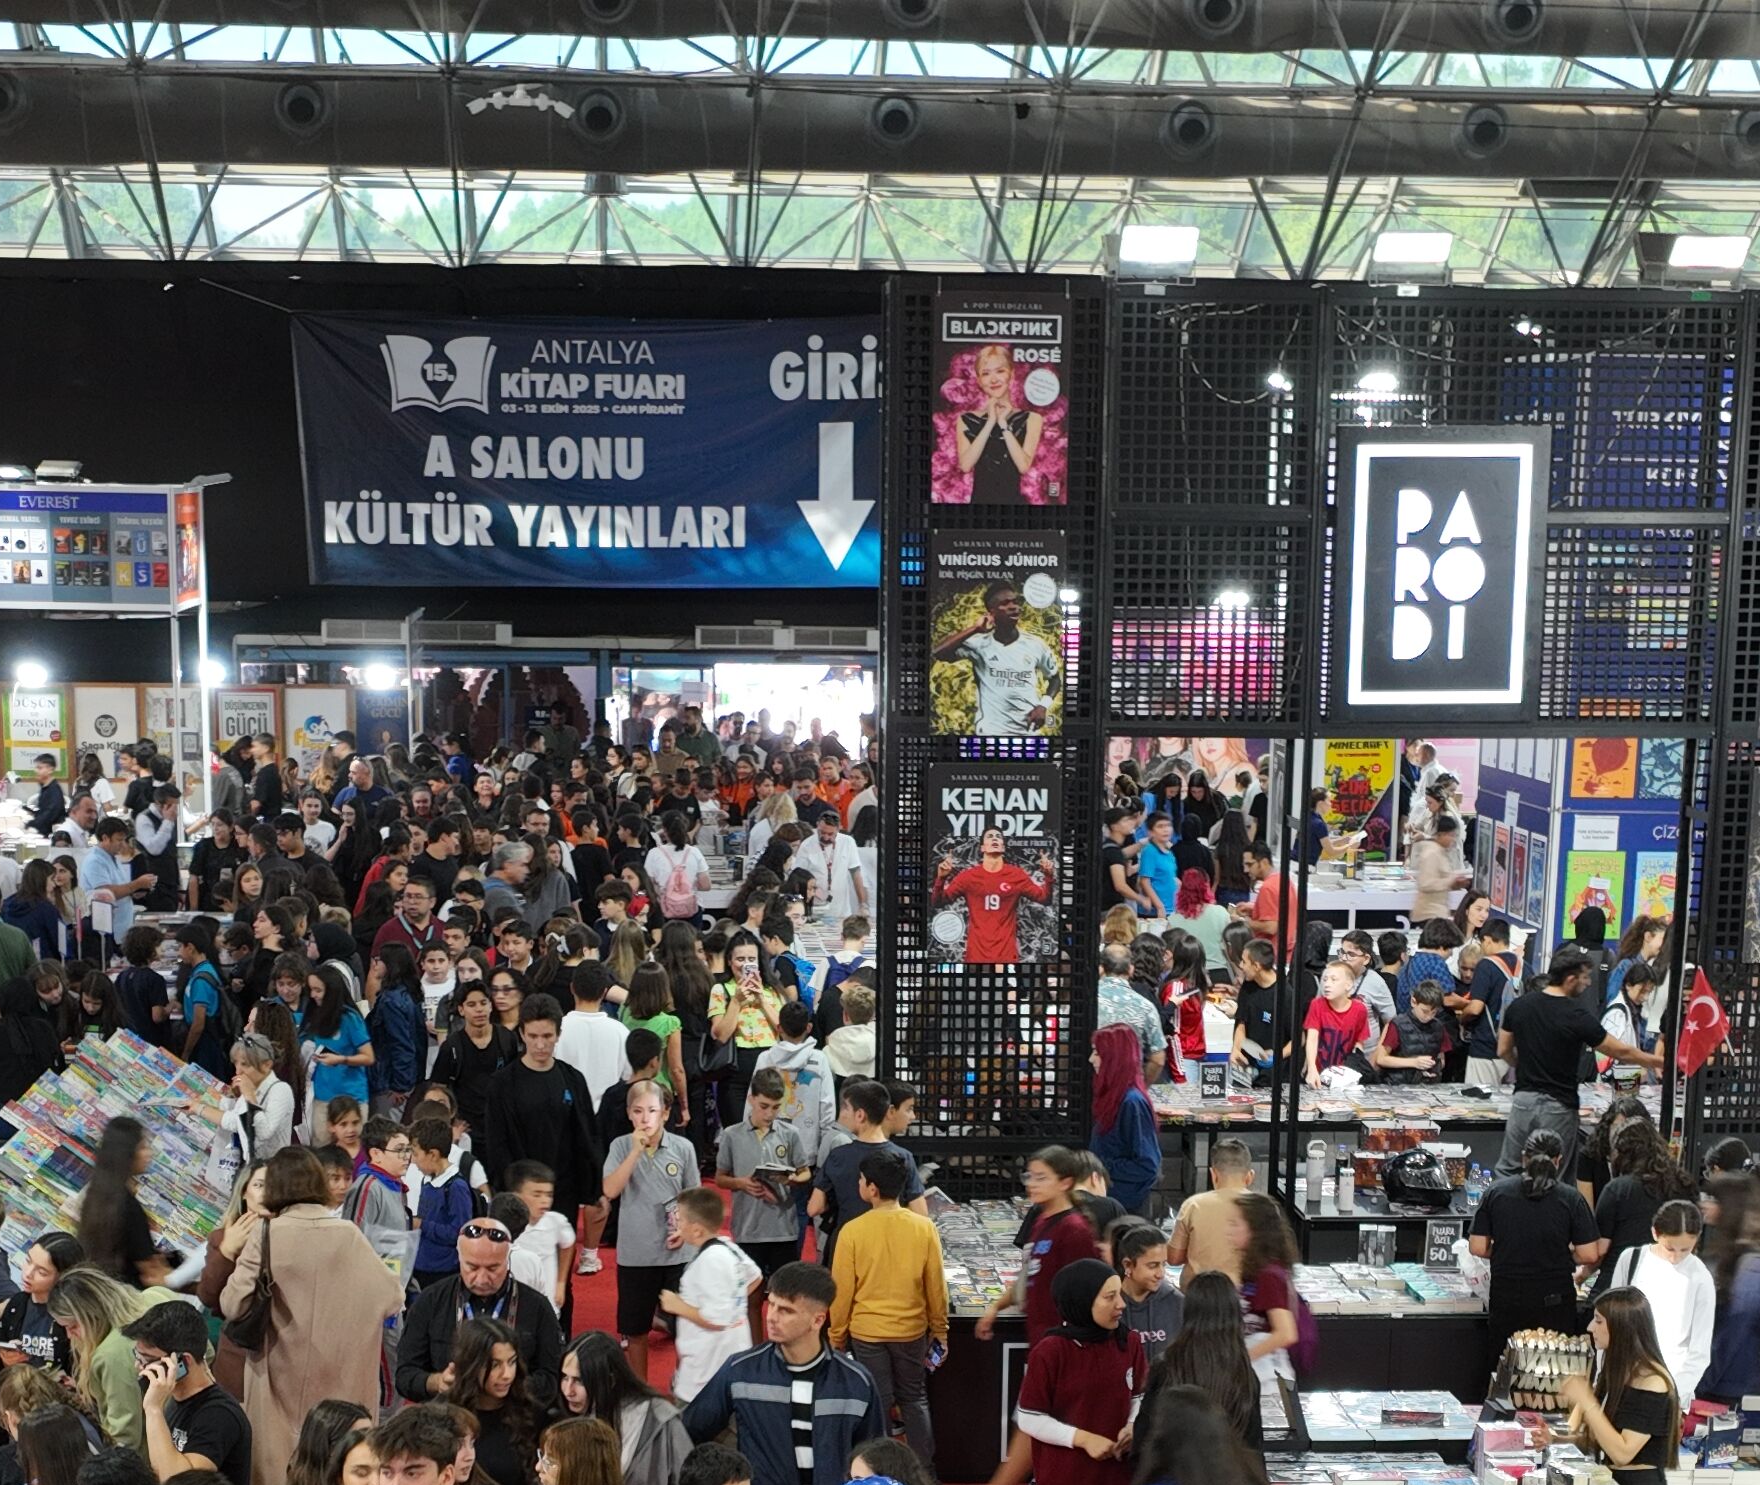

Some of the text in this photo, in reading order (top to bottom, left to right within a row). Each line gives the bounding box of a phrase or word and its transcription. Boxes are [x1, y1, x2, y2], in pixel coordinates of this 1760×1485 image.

[530, 340, 655, 365] ANTALYA
[1013, 347, 1062, 363] ROSÉ
[423, 363, 455, 381] 15.
[769, 334, 883, 402] GİRİ
[500, 366, 686, 400] KİTAP FUARI
[501, 402, 686, 415] 03-12 EKİM 2025 CAM PİRAMİT
[424, 435, 645, 481] A SALONU
[324, 489, 747, 548] KÜLTÜR YAYINLARI
[938, 551, 1059, 568] VINÍCIUS JÚNIOR
[12, 717, 57, 729] ZENGİN
[26, 728, 41, 738] OL
[226, 712, 269, 738] GÜCÜ
[81, 740, 102, 754] Saga
[941, 788, 1049, 812] KENAN
[947, 814, 1044, 837] YILDIZ
[984, 895, 1000, 910] 19
